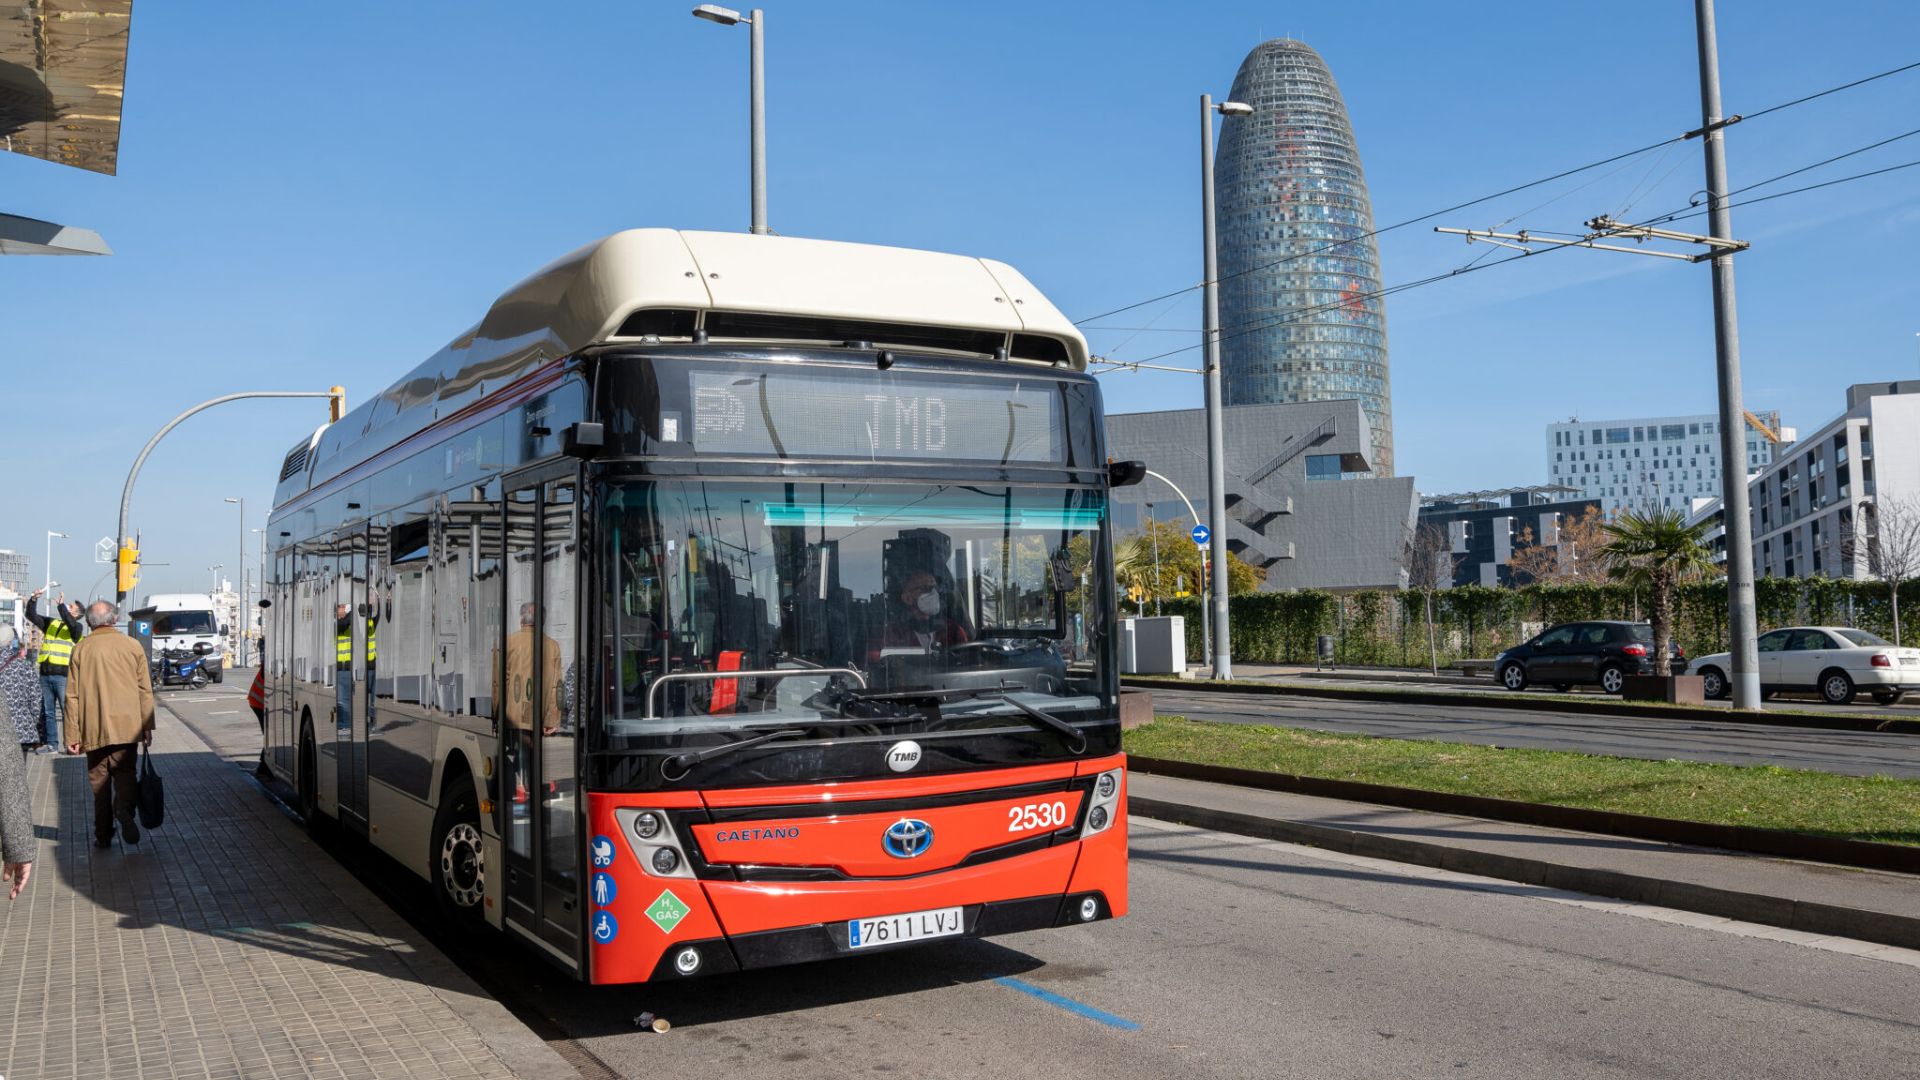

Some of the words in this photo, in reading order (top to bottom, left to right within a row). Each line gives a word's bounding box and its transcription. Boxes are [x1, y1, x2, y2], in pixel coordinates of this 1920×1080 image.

[865, 395, 946, 451] TMB
[140, 622, 148, 634] P
[894, 752, 918, 762] TMB
[1008, 801, 1066, 832] 2530
[716, 827, 800, 842] CAETANO
[656, 910, 680, 920] GAS
[864, 917, 912, 943] 7611
[922, 911, 958, 935] LVJ
